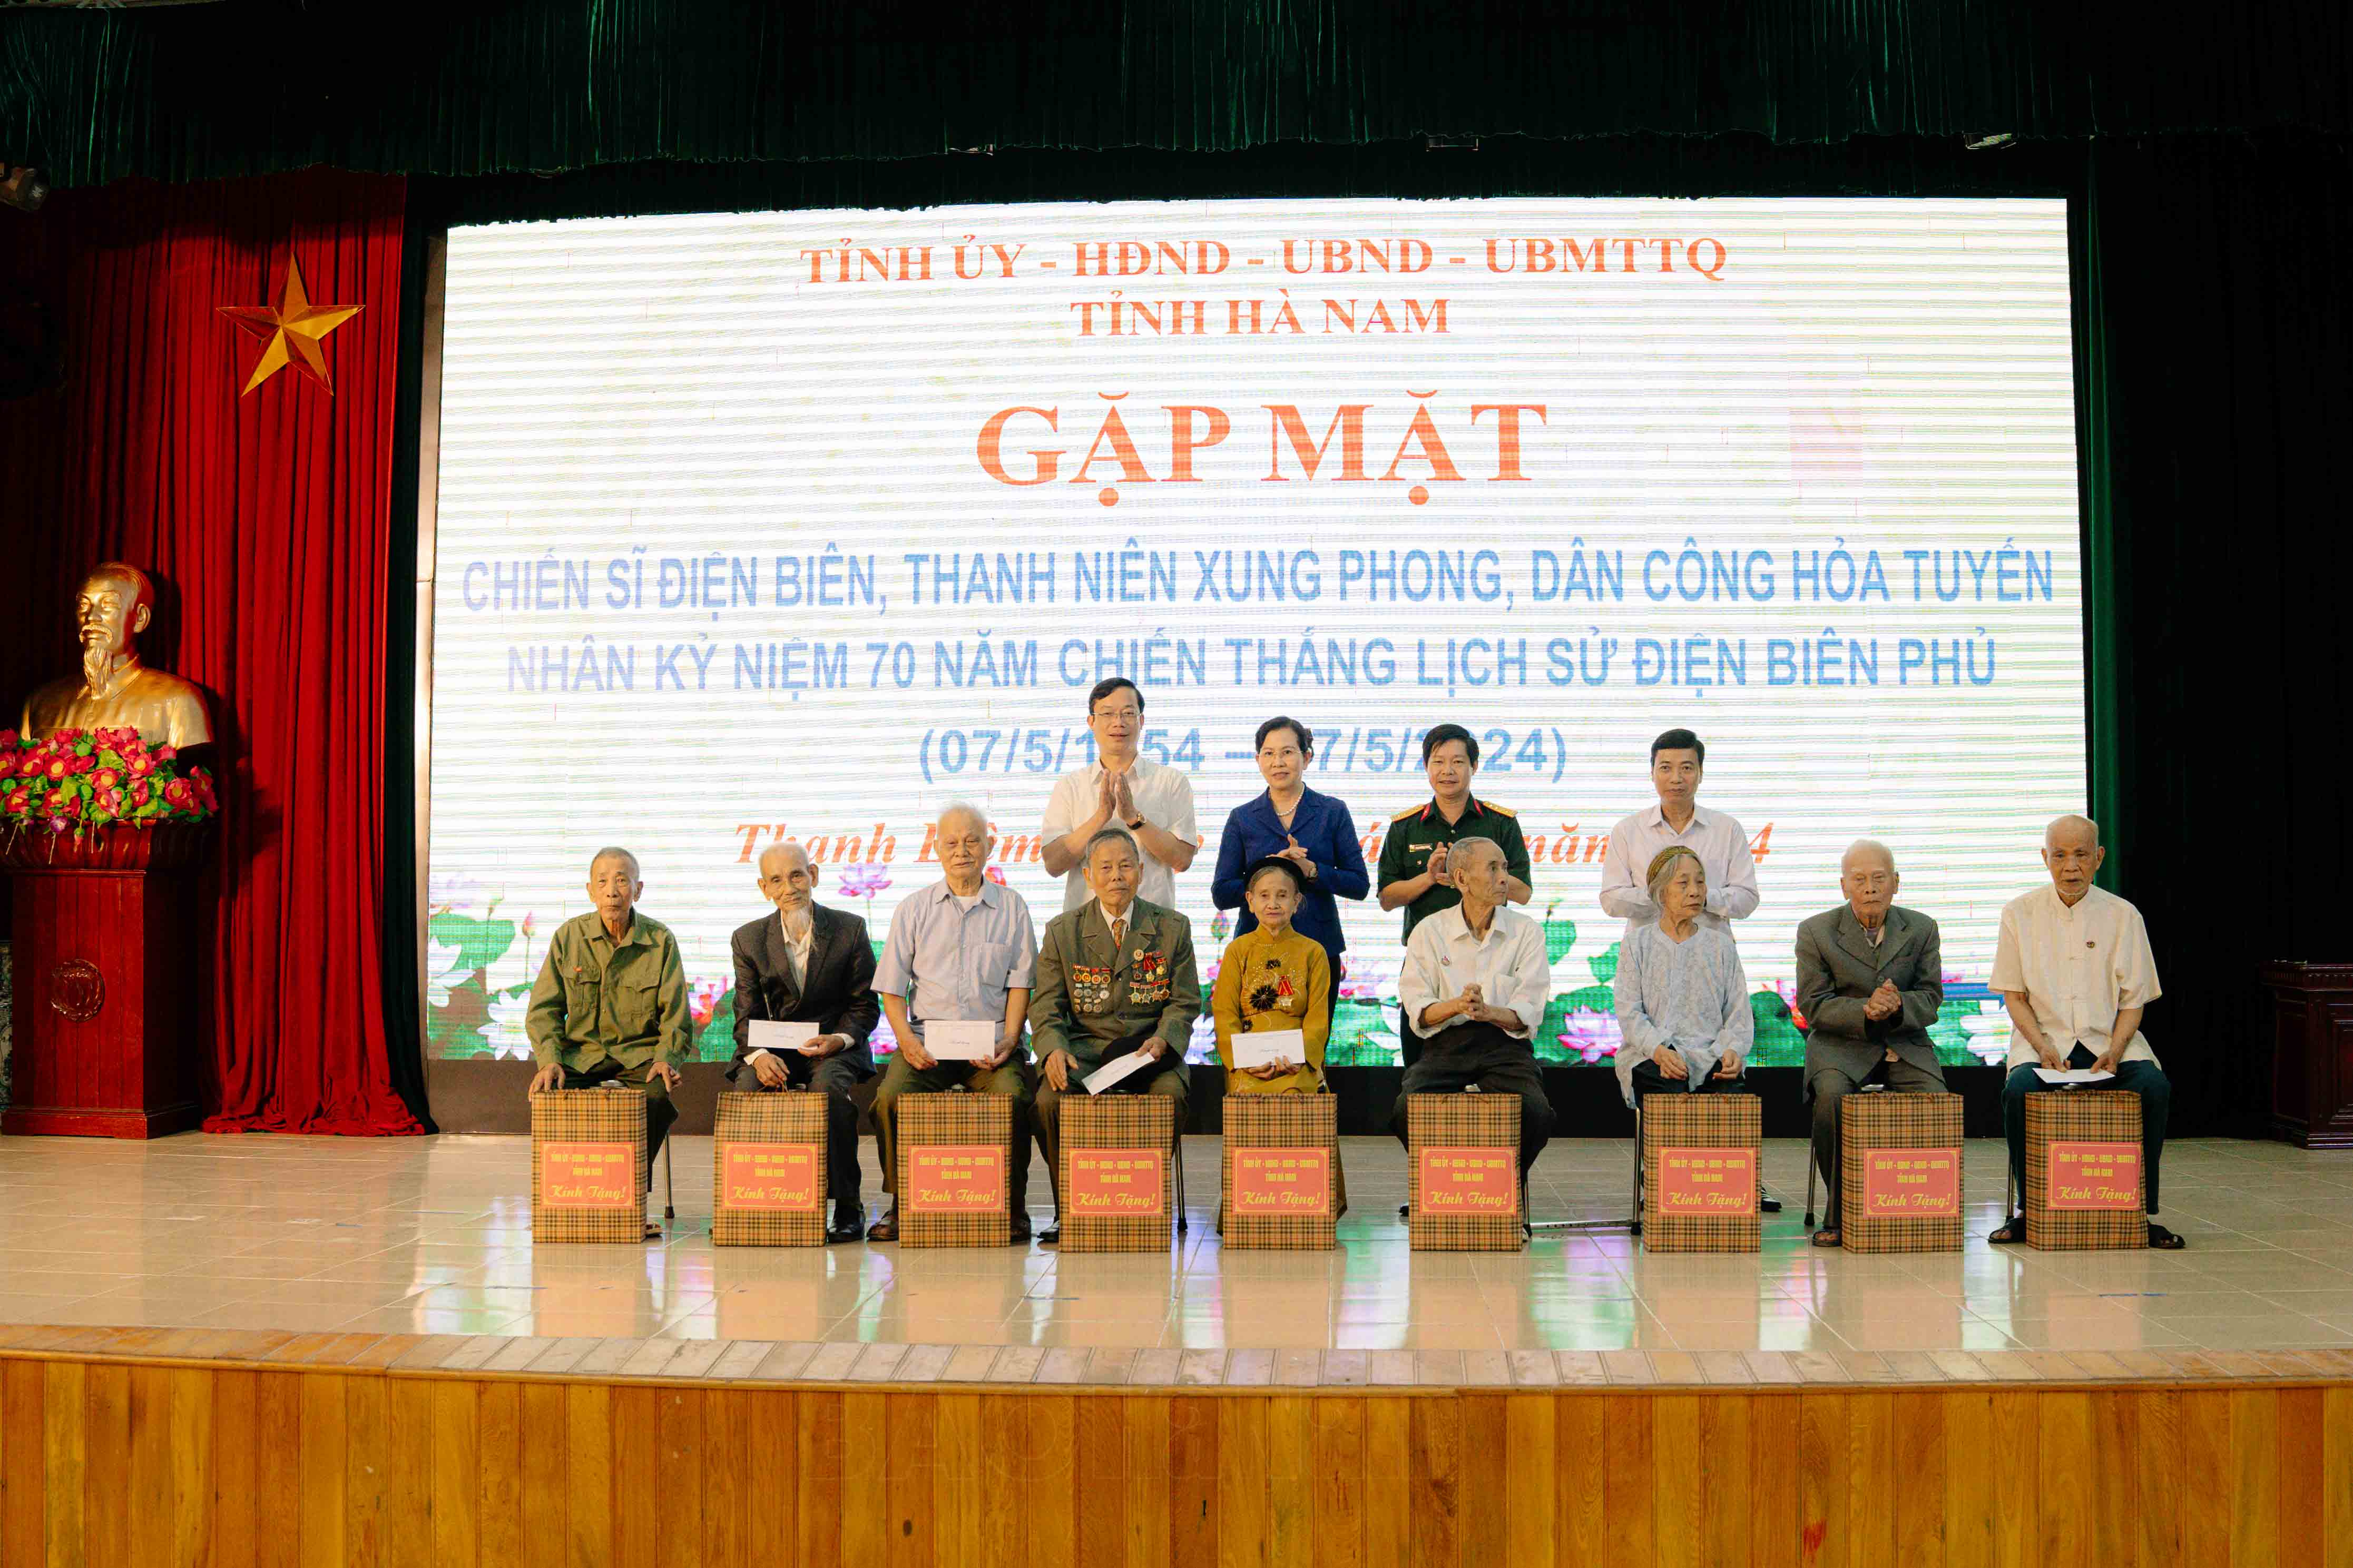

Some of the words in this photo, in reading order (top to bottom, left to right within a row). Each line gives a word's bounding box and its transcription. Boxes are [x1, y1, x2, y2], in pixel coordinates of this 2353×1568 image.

[800, 238, 932, 284] TỈNH
[954, 234, 1025, 280] ỦY
[1075, 240, 1230, 277] HĐND
[1283, 239, 1433, 274] UBND
[1486, 238, 1727, 282] UBMTTQ
[1070, 290, 1206, 336] TỈNH
[1228, 289, 1303, 335] HÀ
[1323, 299, 1450, 334] NAM
[976, 390, 1231, 507] GẶP
[1261, 389, 1547, 506] MẶT
[462, 547, 590, 611] CHIẾN
[605, 545, 648, 609] SĨ
[657, 551, 758, 622] ĐIỆN
[775, 541, 887, 617] BIÊN,
[903, 551, 1055, 605] THANH
[1074, 536, 1177, 603] NIÊN
[1193, 549, 1322, 604] XUNG
[1339, 549, 1514, 613] PHONG,
[1531, 535, 1625, 603] DÂN
[1642, 535, 1776, 602] CÔNG
[1792, 535, 1891, 603] HỎA
[1902, 535, 2053, 604] TUYẾN
[508, 633, 634, 692] NHÂN
[654, 632, 718, 691] KỶ
[734, 636, 848, 701] NIỆM
[866, 640, 916, 688] 70
[934, 628, 1038, 687] NĂM
[1057, 627, 1207, 686] CHIẾN
[1223, 626, 1398, 687] THẮNG
[1416, 637, 1527, 698] LỊCH
[1546, 626, 1619, 687] SỬ
[1630, 632, 1747, 699] ĐIỆN
[1766, 626, 1879, 687] BIÊN
[1897, 626, 1996, 687] PHỦ
[919, 727, 1205, 784] (07/5/154
